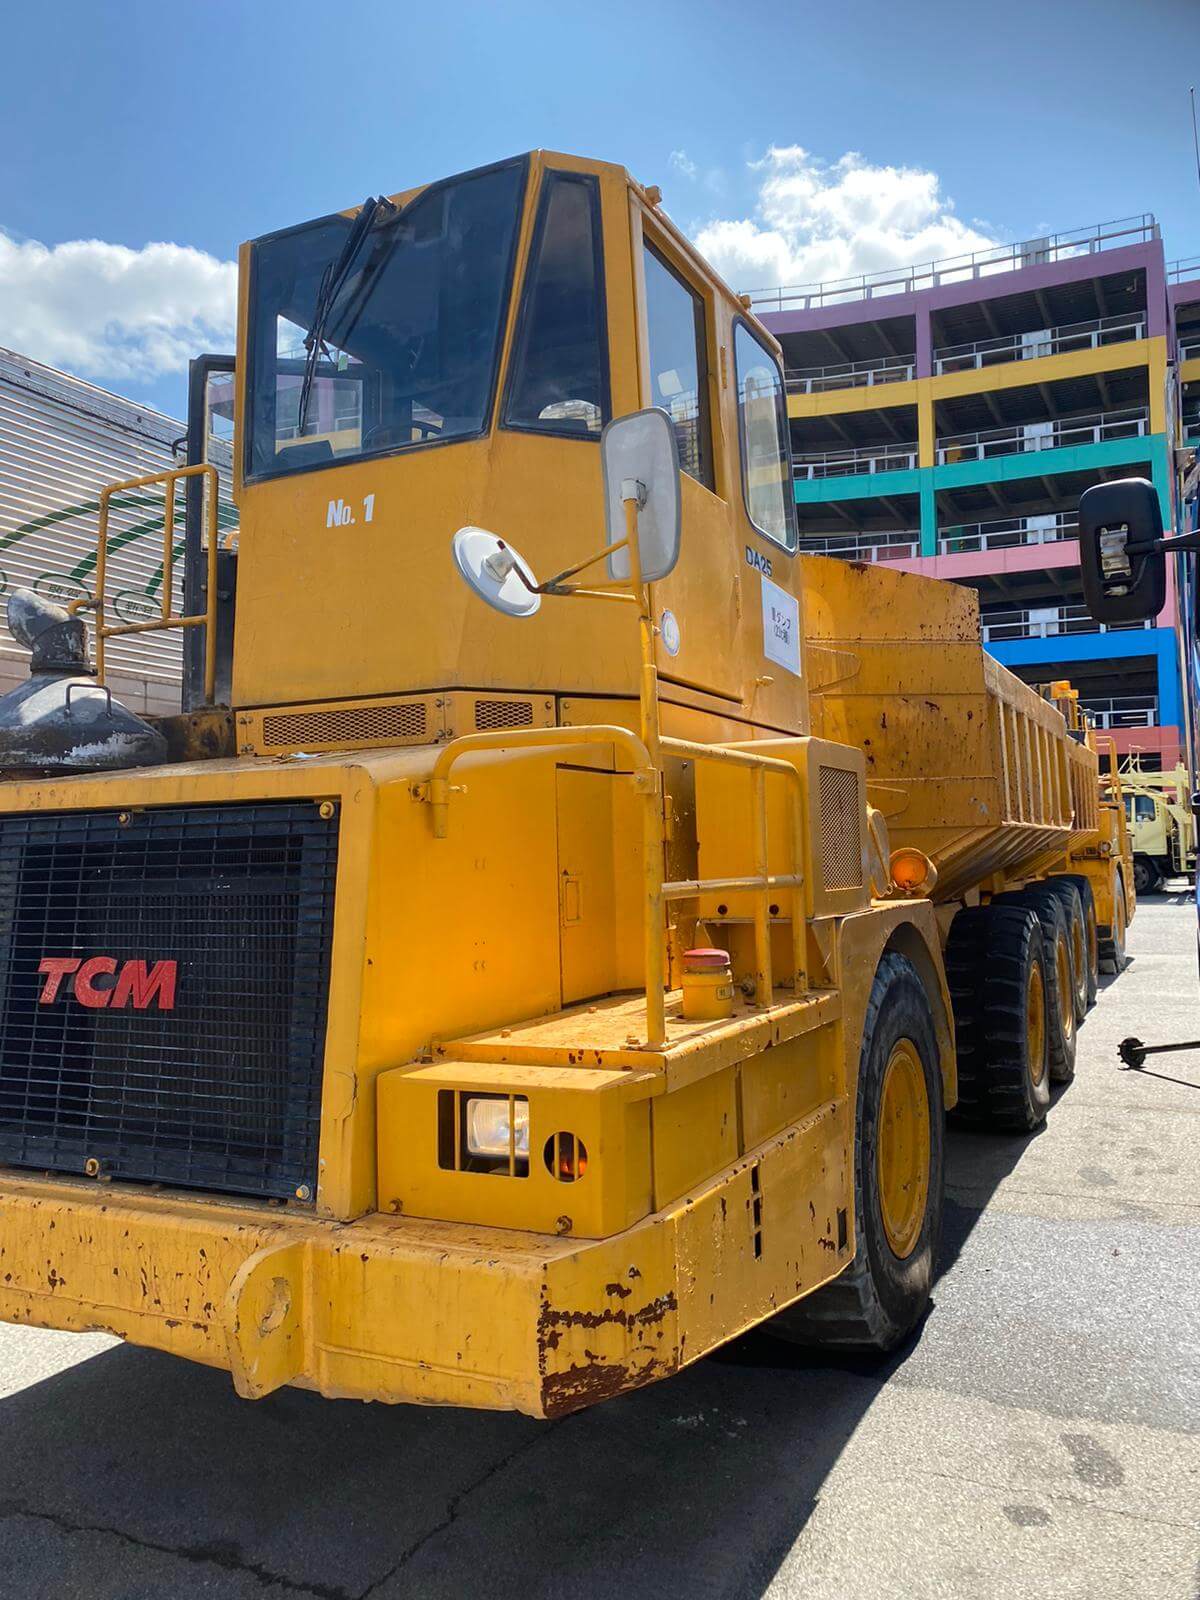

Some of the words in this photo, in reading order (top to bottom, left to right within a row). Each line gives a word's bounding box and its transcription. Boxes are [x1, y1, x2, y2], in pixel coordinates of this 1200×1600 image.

[326, 498, 356, 528] No.
[363, 493, 376, 522] 1
[745, 545, 773, 577] DA25
[37, 956, 178, 1010] TCM
